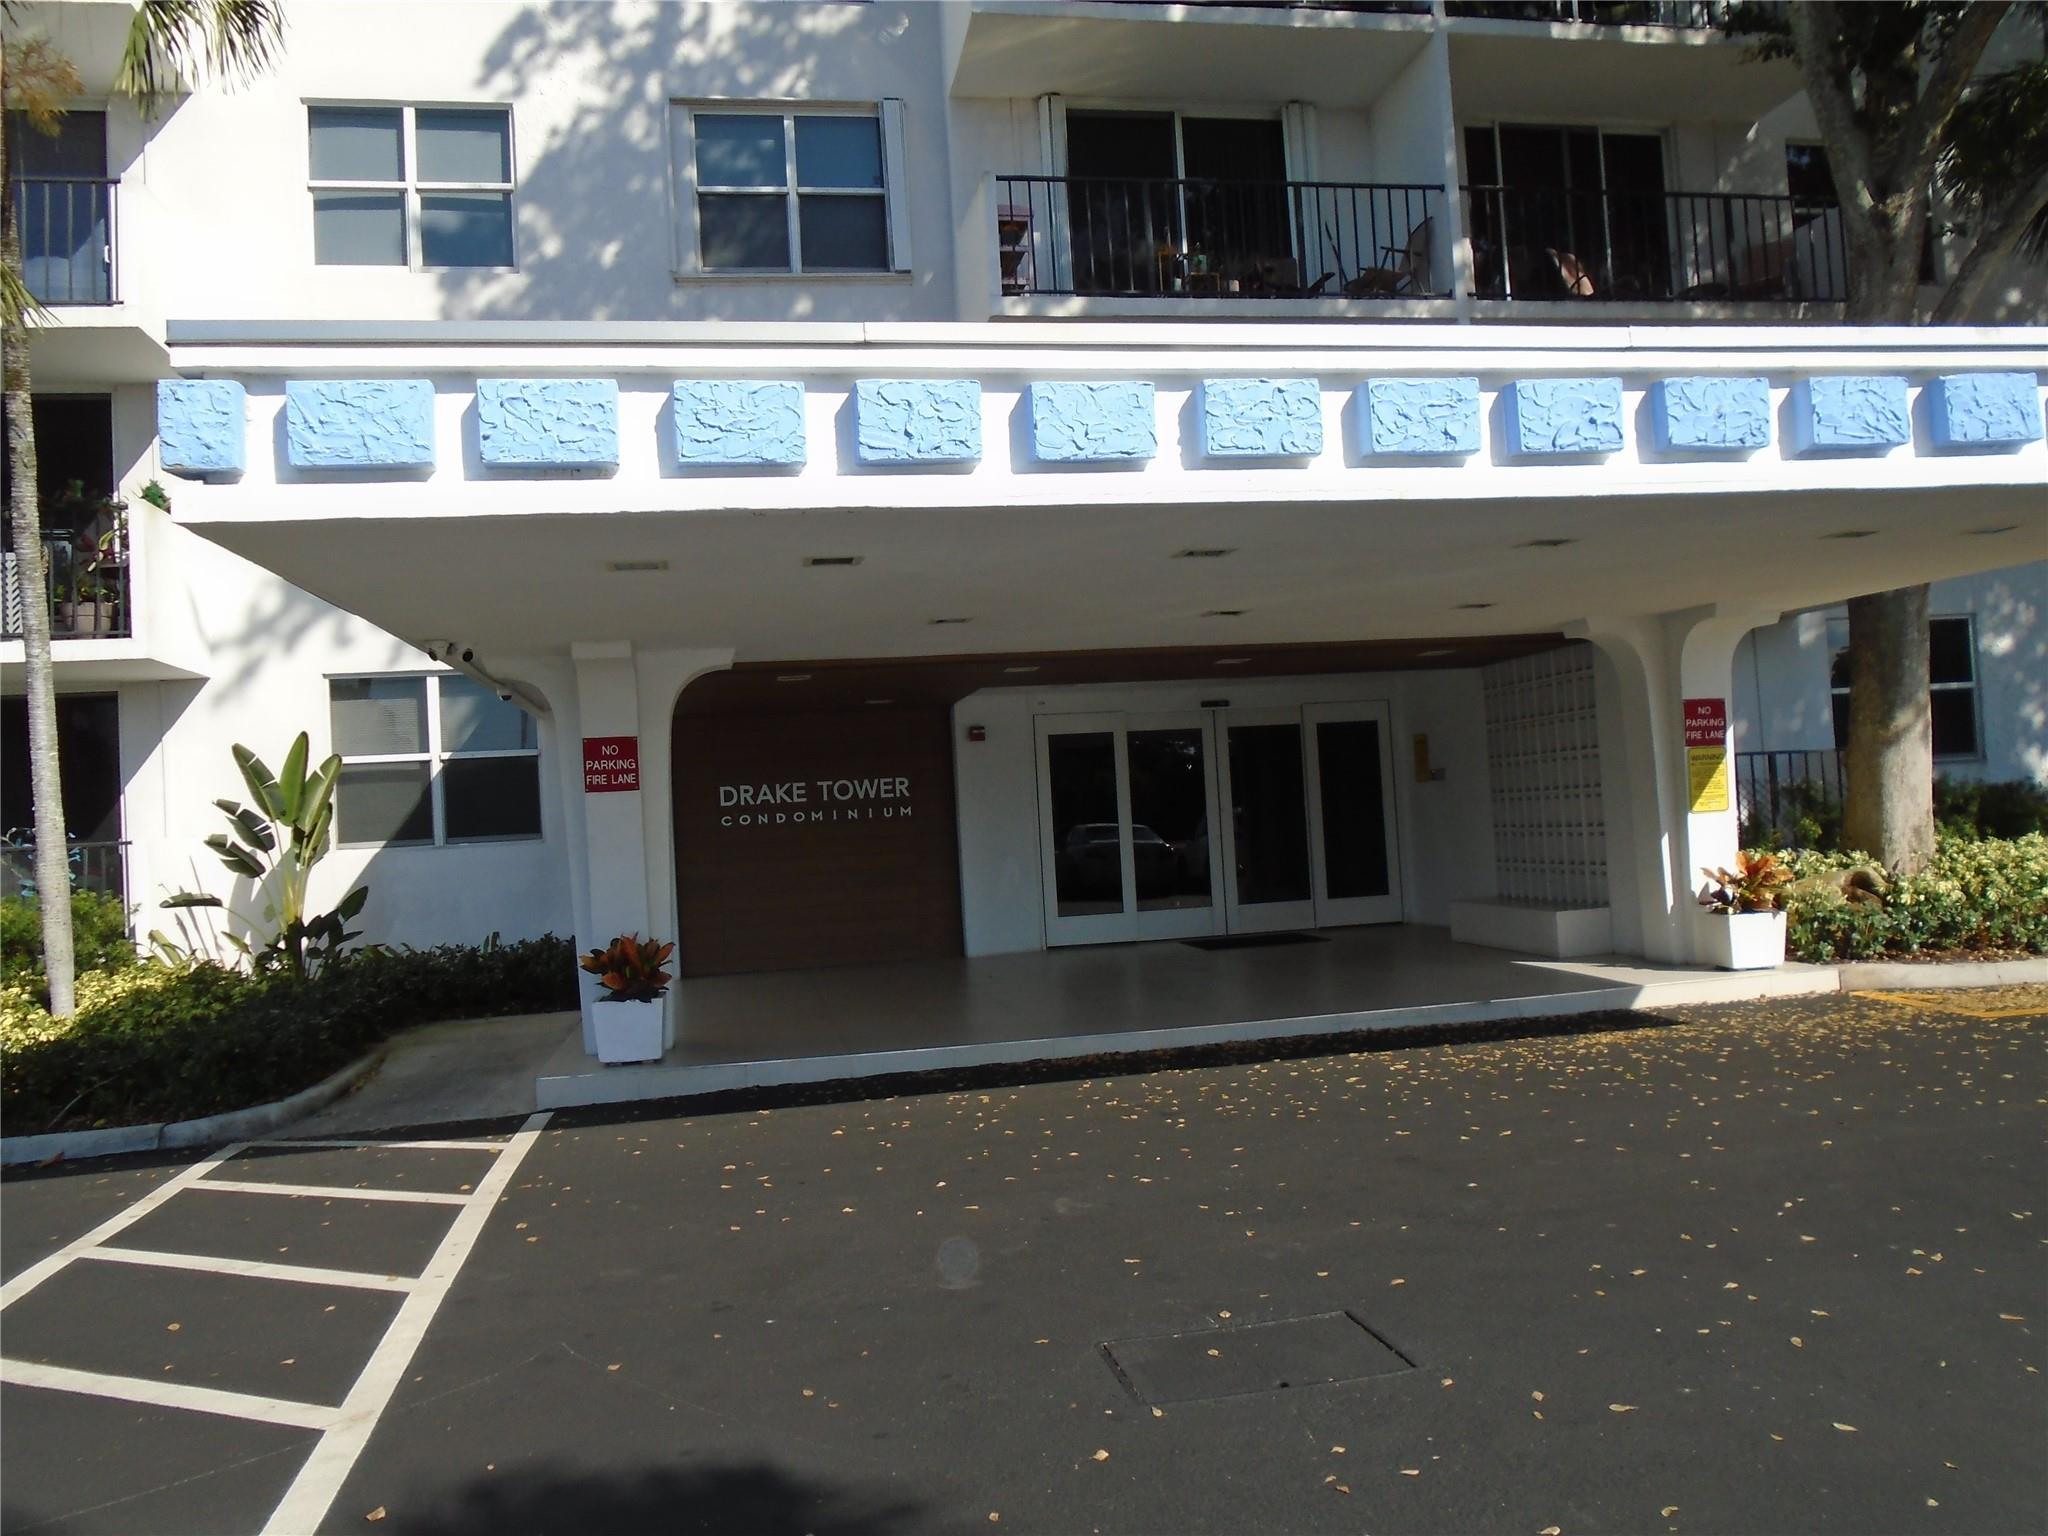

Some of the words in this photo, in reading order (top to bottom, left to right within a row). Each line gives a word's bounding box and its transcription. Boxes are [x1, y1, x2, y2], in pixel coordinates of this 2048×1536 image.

[1697, 706, 1711, 715] NO
[1686, 718, 1724, 727] PARKING
[1686, 731, 1702, 739] FIRE
[1705, 730, 1725, 739] LANE
[601, 745, 619, 756] NO
[586, 759, 636, 771] PARKING
[586, 774, 607, 785] FIRE
[611, 773, 636, 784] LANE
[719, 782, 807, 807] DRAKE
[817, 777, 910, 801] TOWER
[721, 806, 912, 826] CONDOMINIUM
